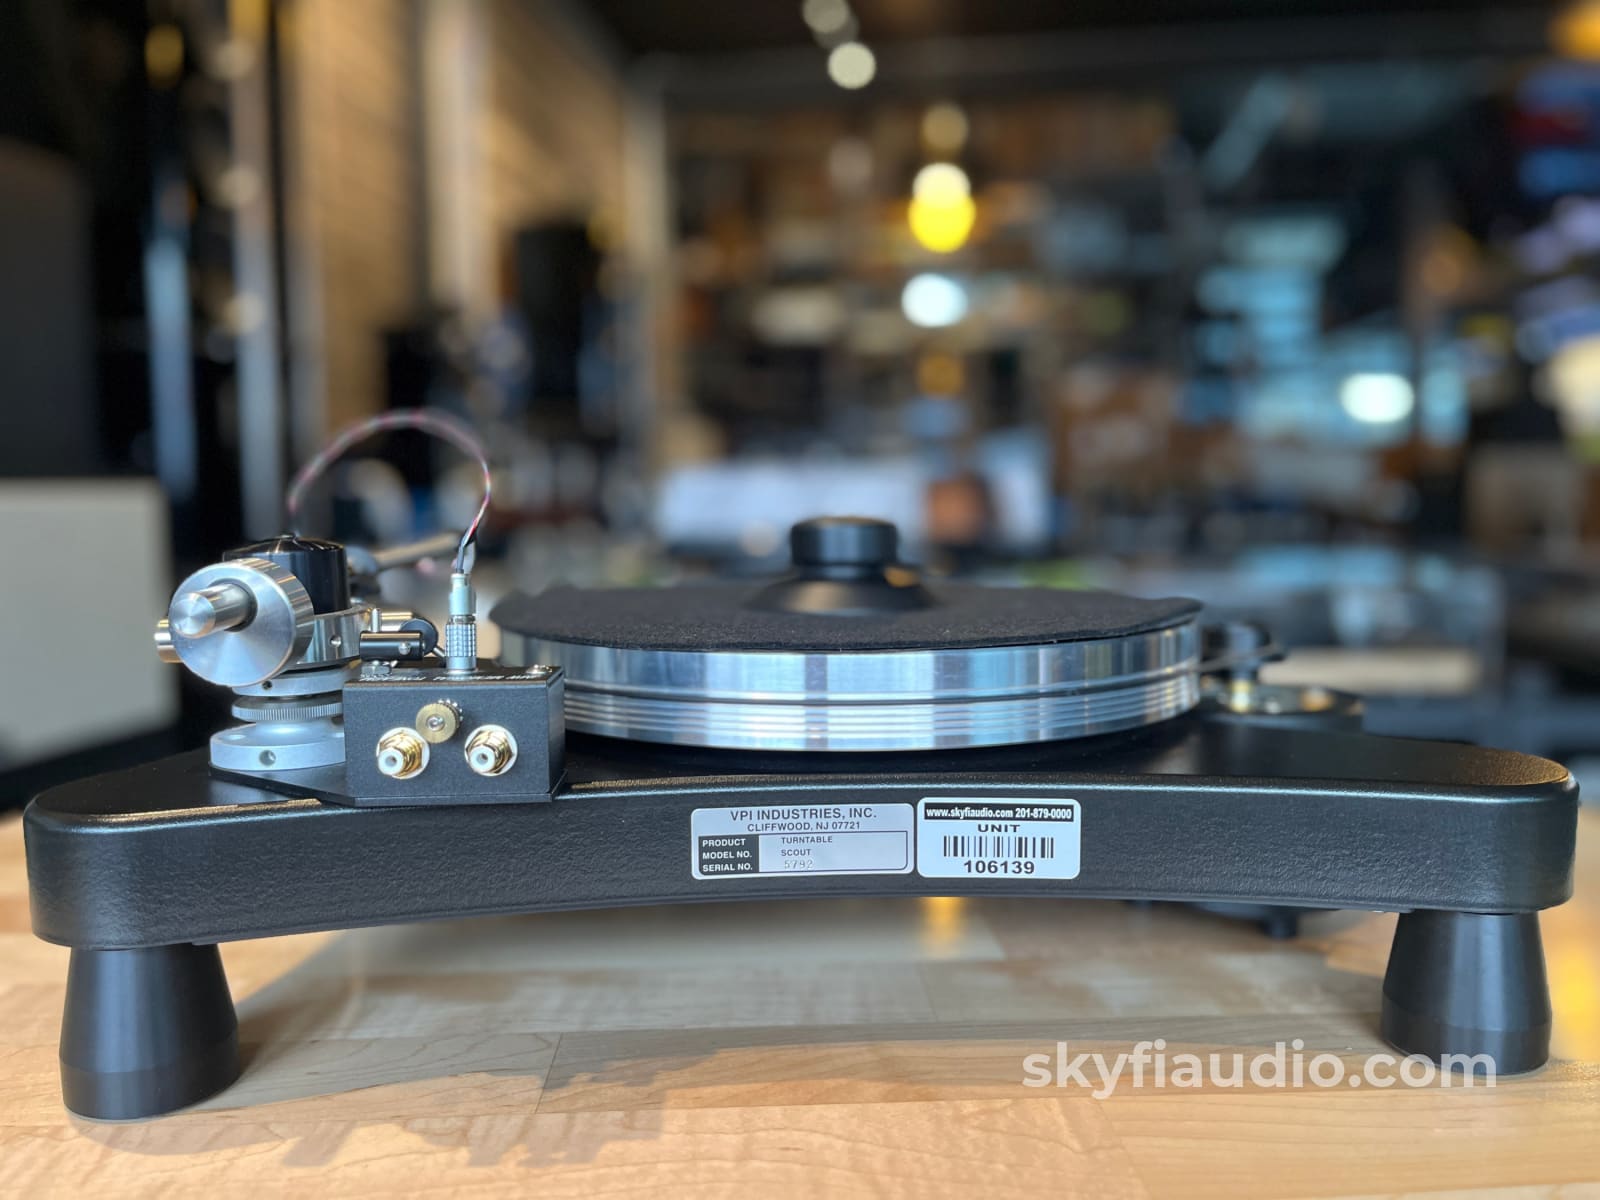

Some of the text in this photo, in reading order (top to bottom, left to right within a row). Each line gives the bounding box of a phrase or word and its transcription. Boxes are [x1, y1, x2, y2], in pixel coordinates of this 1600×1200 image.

[730, 807, 877, 822] VPI INDUSTRIES, INC.
[926, 806, 1072, 819] www.skyfiaudio.com 201-879-0000
[747, 821, 860, 832] CLIFFWOOD, NJ 07721
[977, 824, 1020, 833] UNIT
[702, 838, 746, 847] PRODUCT
[782, 835, 833, 844] TURNTABLE
[702, 850, 752, 860] MODEL NO.
[781, 848, 812, 857] SCOUT
[702, 862, 753, 872] SERIAL NO.
[964, 860, 1035, 874] 106139
